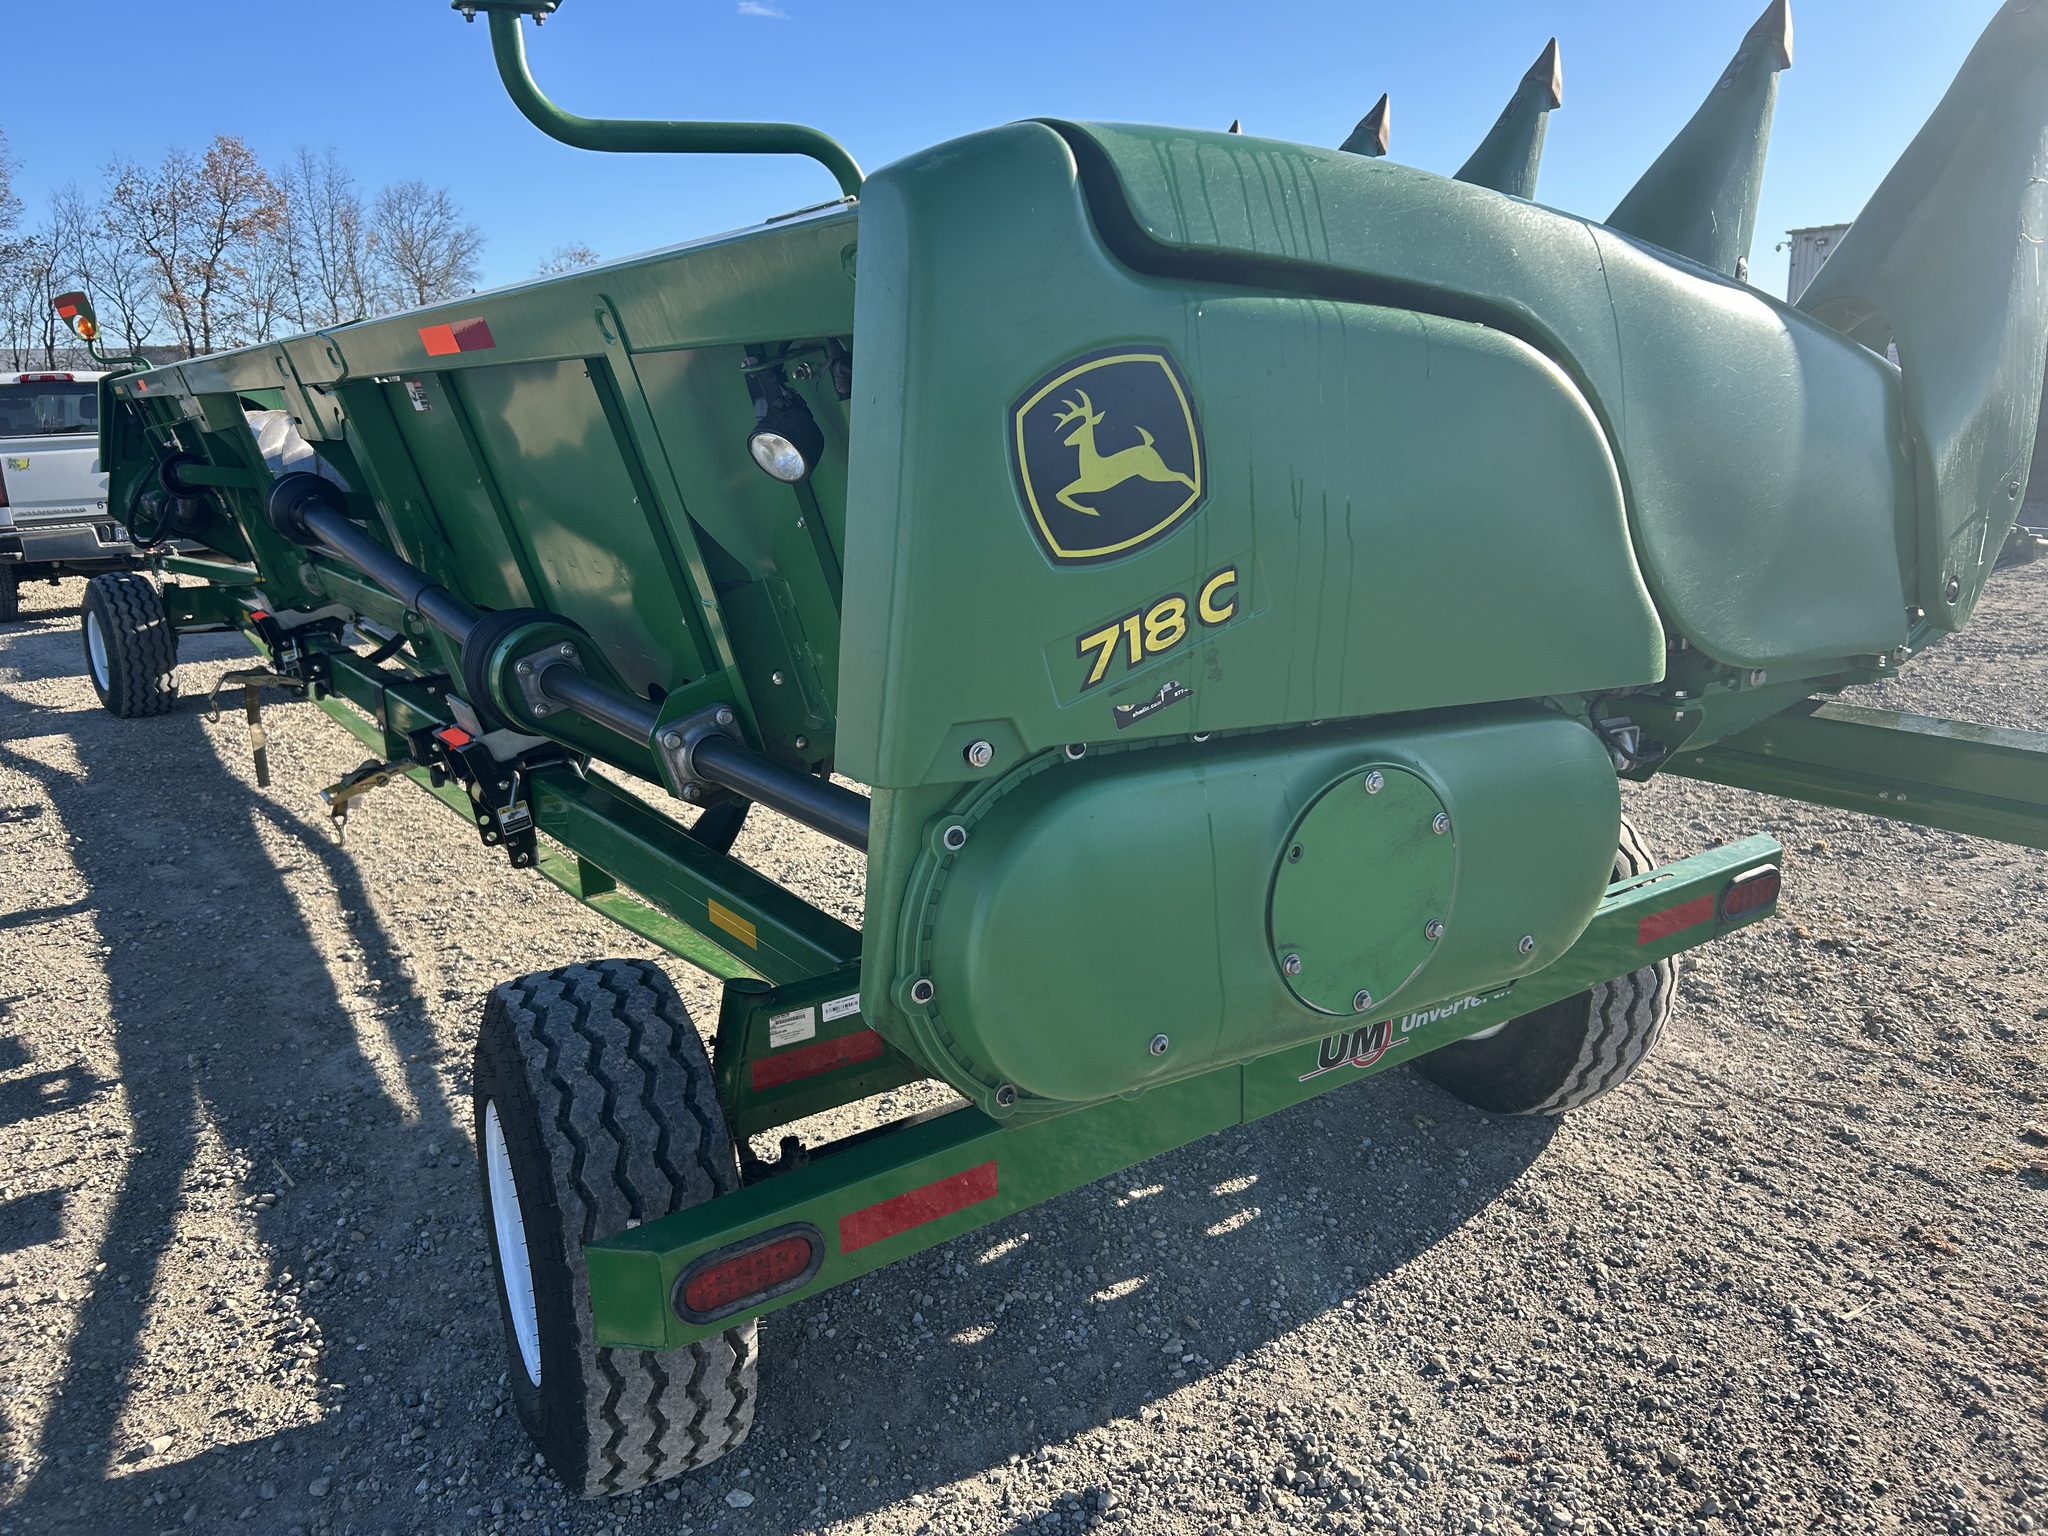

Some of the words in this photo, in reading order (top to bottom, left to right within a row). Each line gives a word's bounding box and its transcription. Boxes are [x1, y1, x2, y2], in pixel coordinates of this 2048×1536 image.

[1077, 593, 1188, 692] 718
[1197, 565, 1239, 628] C
[1318, 1019, 1392, 1069] UM
[1401, 988, 1512, 1033] Unverfe
